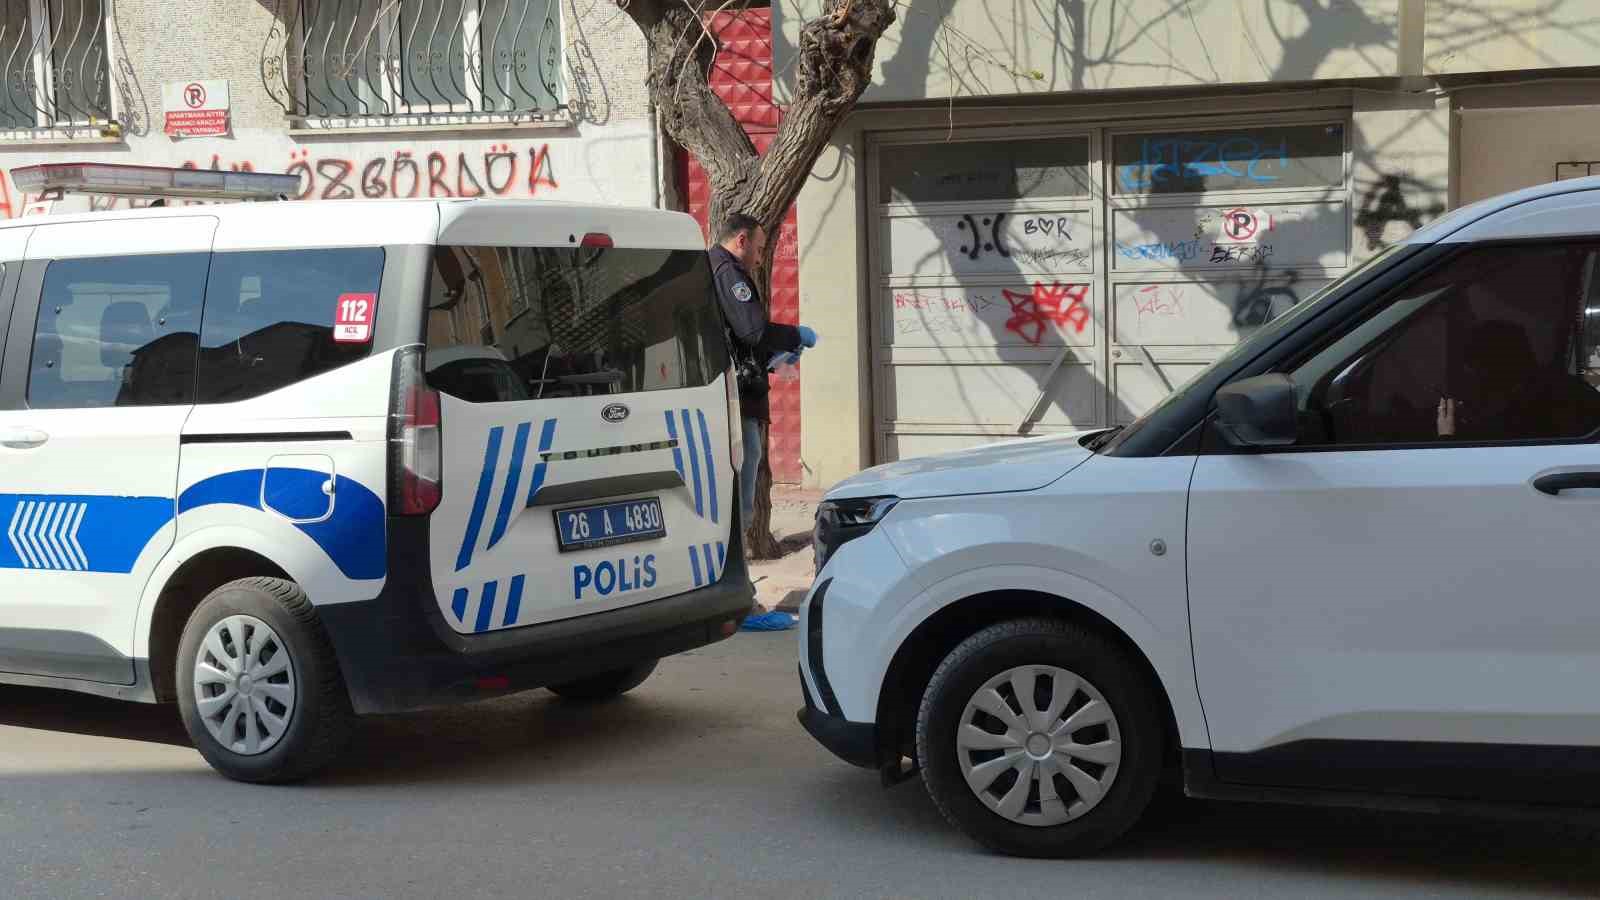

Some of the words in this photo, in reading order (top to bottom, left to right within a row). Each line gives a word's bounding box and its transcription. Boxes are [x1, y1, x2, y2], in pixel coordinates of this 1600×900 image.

[341, 299, 368, 322] 112
[568, 511, 590, 540] 26
[603, 509, 614, 536] A
[625, 502, 660, 532] 4830
